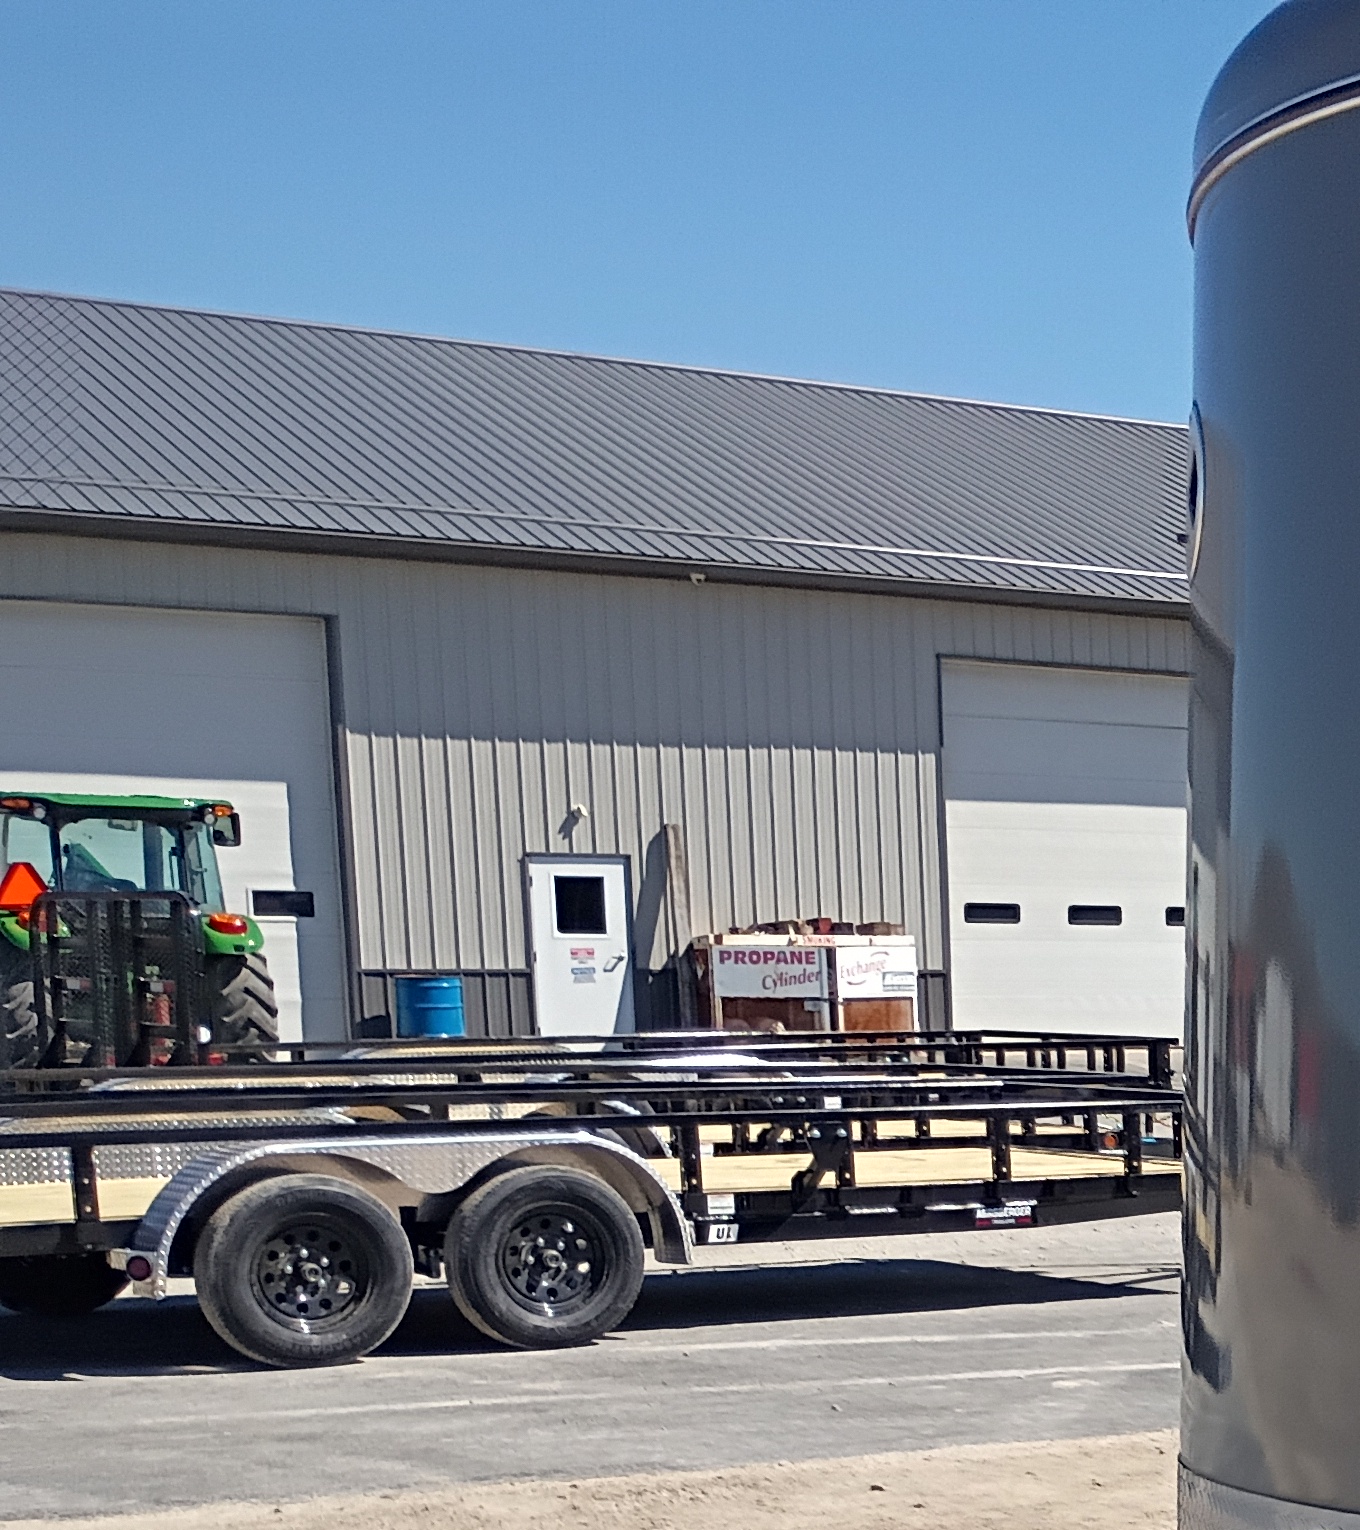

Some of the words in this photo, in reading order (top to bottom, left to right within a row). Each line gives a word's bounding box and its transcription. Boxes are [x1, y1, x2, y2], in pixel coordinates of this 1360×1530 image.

[718, 950, 816, 965] PROPANE
[840, 959, 887, 977] Exchange
[762, 968, 822, 994] Cylinder
